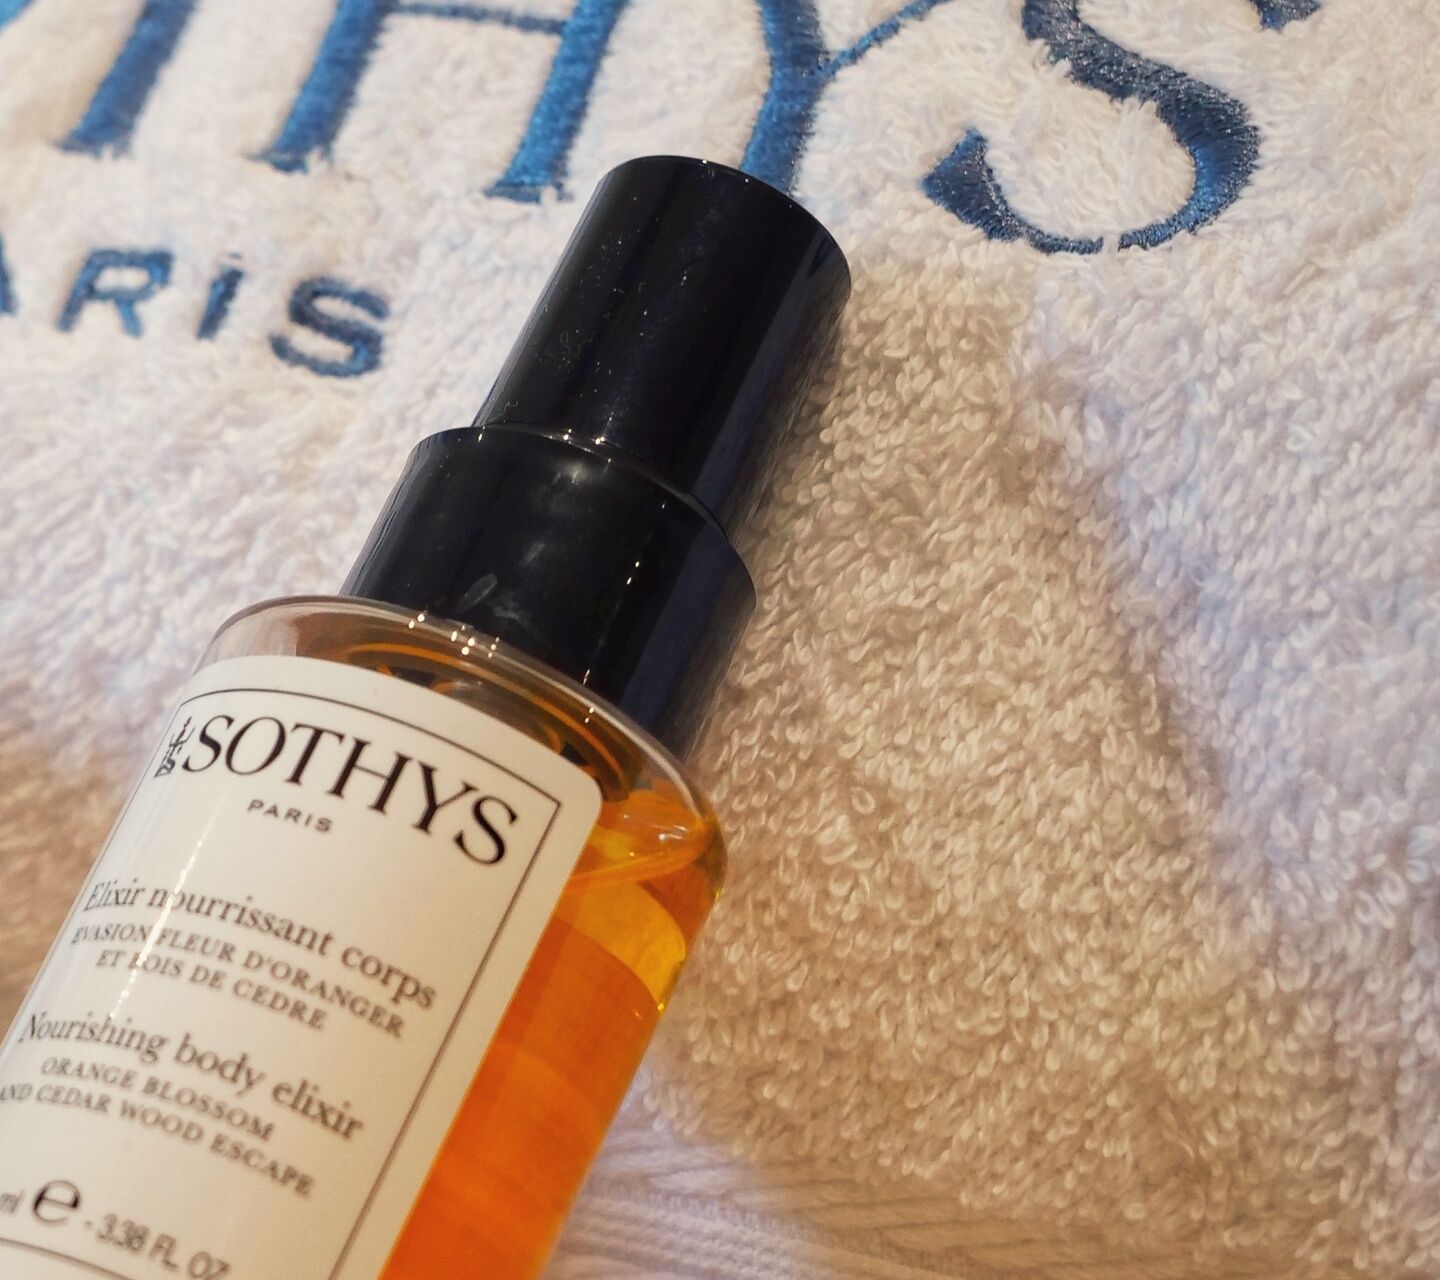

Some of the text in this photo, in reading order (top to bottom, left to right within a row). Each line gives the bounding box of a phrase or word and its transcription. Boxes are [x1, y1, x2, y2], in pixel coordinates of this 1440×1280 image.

[182, 715, 518, 865] SOTHYS
[247, 799, 333, 832] PARIS
[71, 922, 405, 1038] EVASION FLEUR D'ORANGER
[83, 878, 437, 1009] Elixir nourrissant corps
[96, 949, 125, 968] ET
[189, 964, 227, 988] DE
[233, 979, 329, 1029] CEDRE
[18, 1012, 364, 1140] Nourishing body elixir
[41, 1057, 274, 1141] ORANGE BLOSSOM
[36, 1085, 112, 1113] CEDAR
[119, 1101, 204, 1144] WOOD
[210, 1132, 315, 1197] ESCAPE
[96, 1214, 150, 1251] 3.38
[149, 1234, 179, 1270] FL
